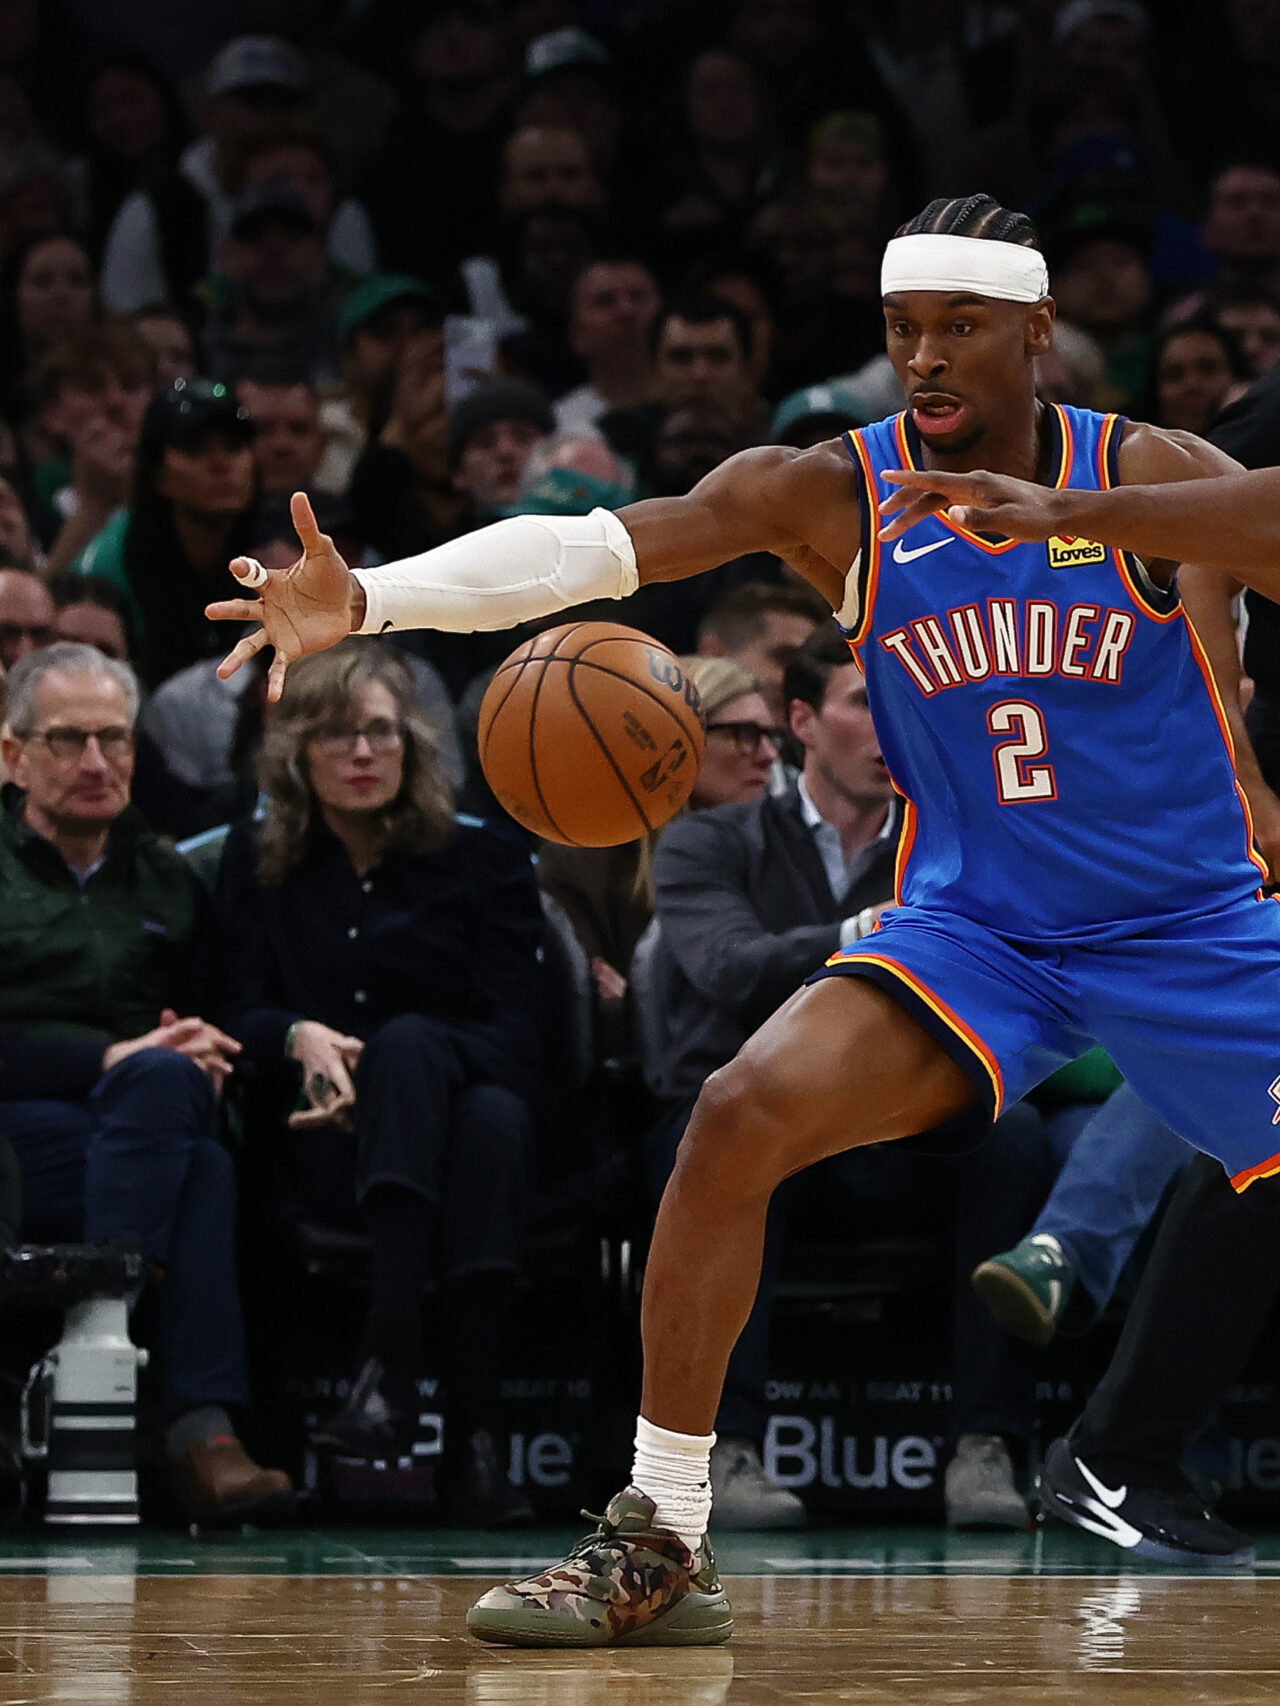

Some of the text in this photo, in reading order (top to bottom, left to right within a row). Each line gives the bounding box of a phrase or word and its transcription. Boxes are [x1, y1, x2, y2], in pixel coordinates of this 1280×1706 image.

[1052, 545, 1103, 564] Loves
[878, 598, 1137, 698] THUNDER
[986, 698, 1058, 805] 2
[762, 1413, 938, 1491] Blue
